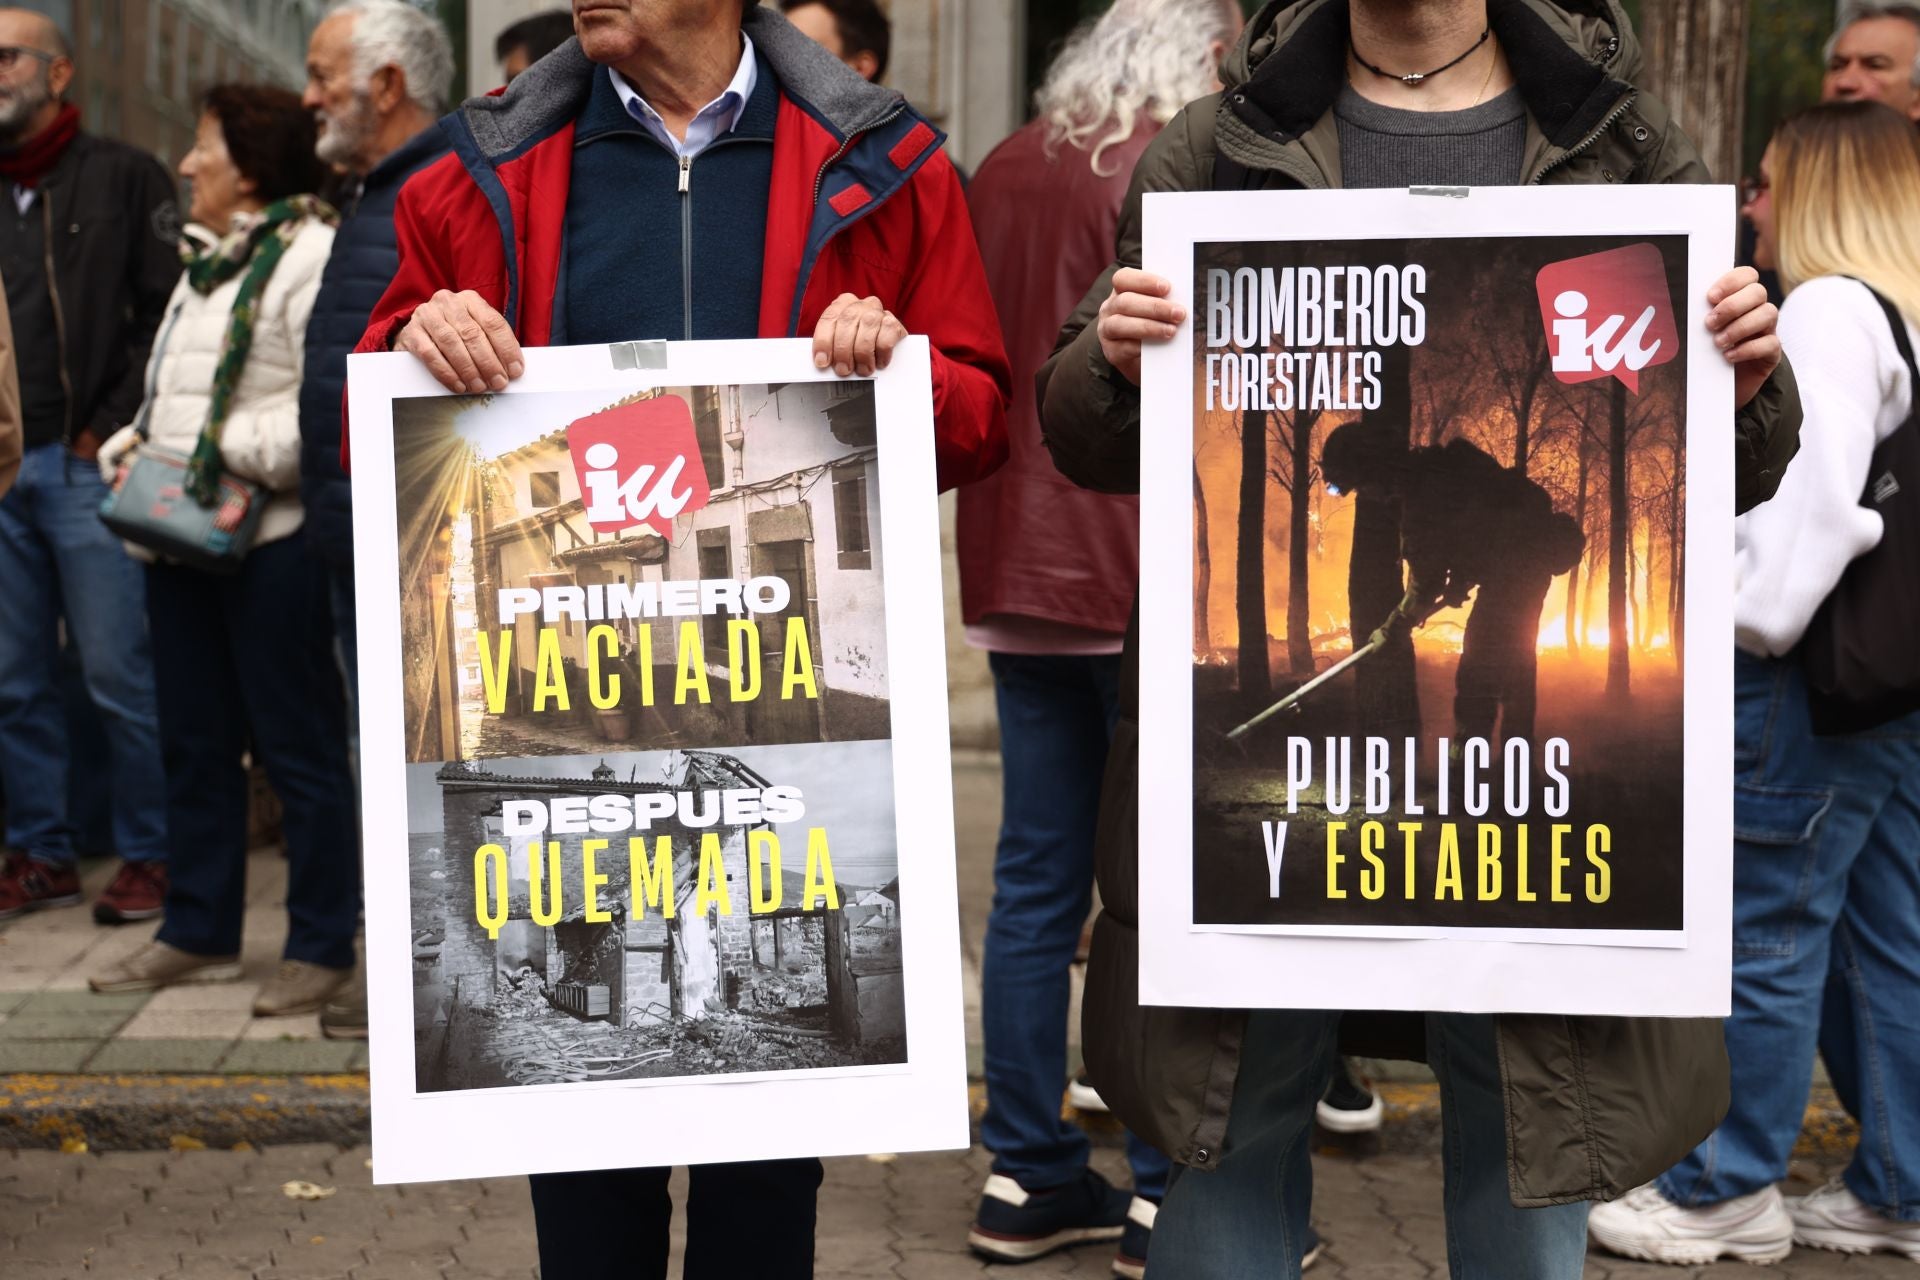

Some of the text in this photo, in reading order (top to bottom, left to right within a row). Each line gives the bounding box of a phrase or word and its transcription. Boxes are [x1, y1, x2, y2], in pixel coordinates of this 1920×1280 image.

[1207, 264, 1426, 348] BOMBEROS
[1552, 290, 1661, 373] iu
[1205, 351, 1382, 411] FORESTALES
[584, 443, 693, 523] iu
[498, 576, 791, 624] PRIMERO
[477, 616, 818, 714] VACIADA
[502, 786, 806, 836] DESPUES
[1286, 736, 1570, 818] PUBLICOS
[473, 827, 839, 940] QUEMADA
[1262, 821, 1611, 904] Y ESTABLES
